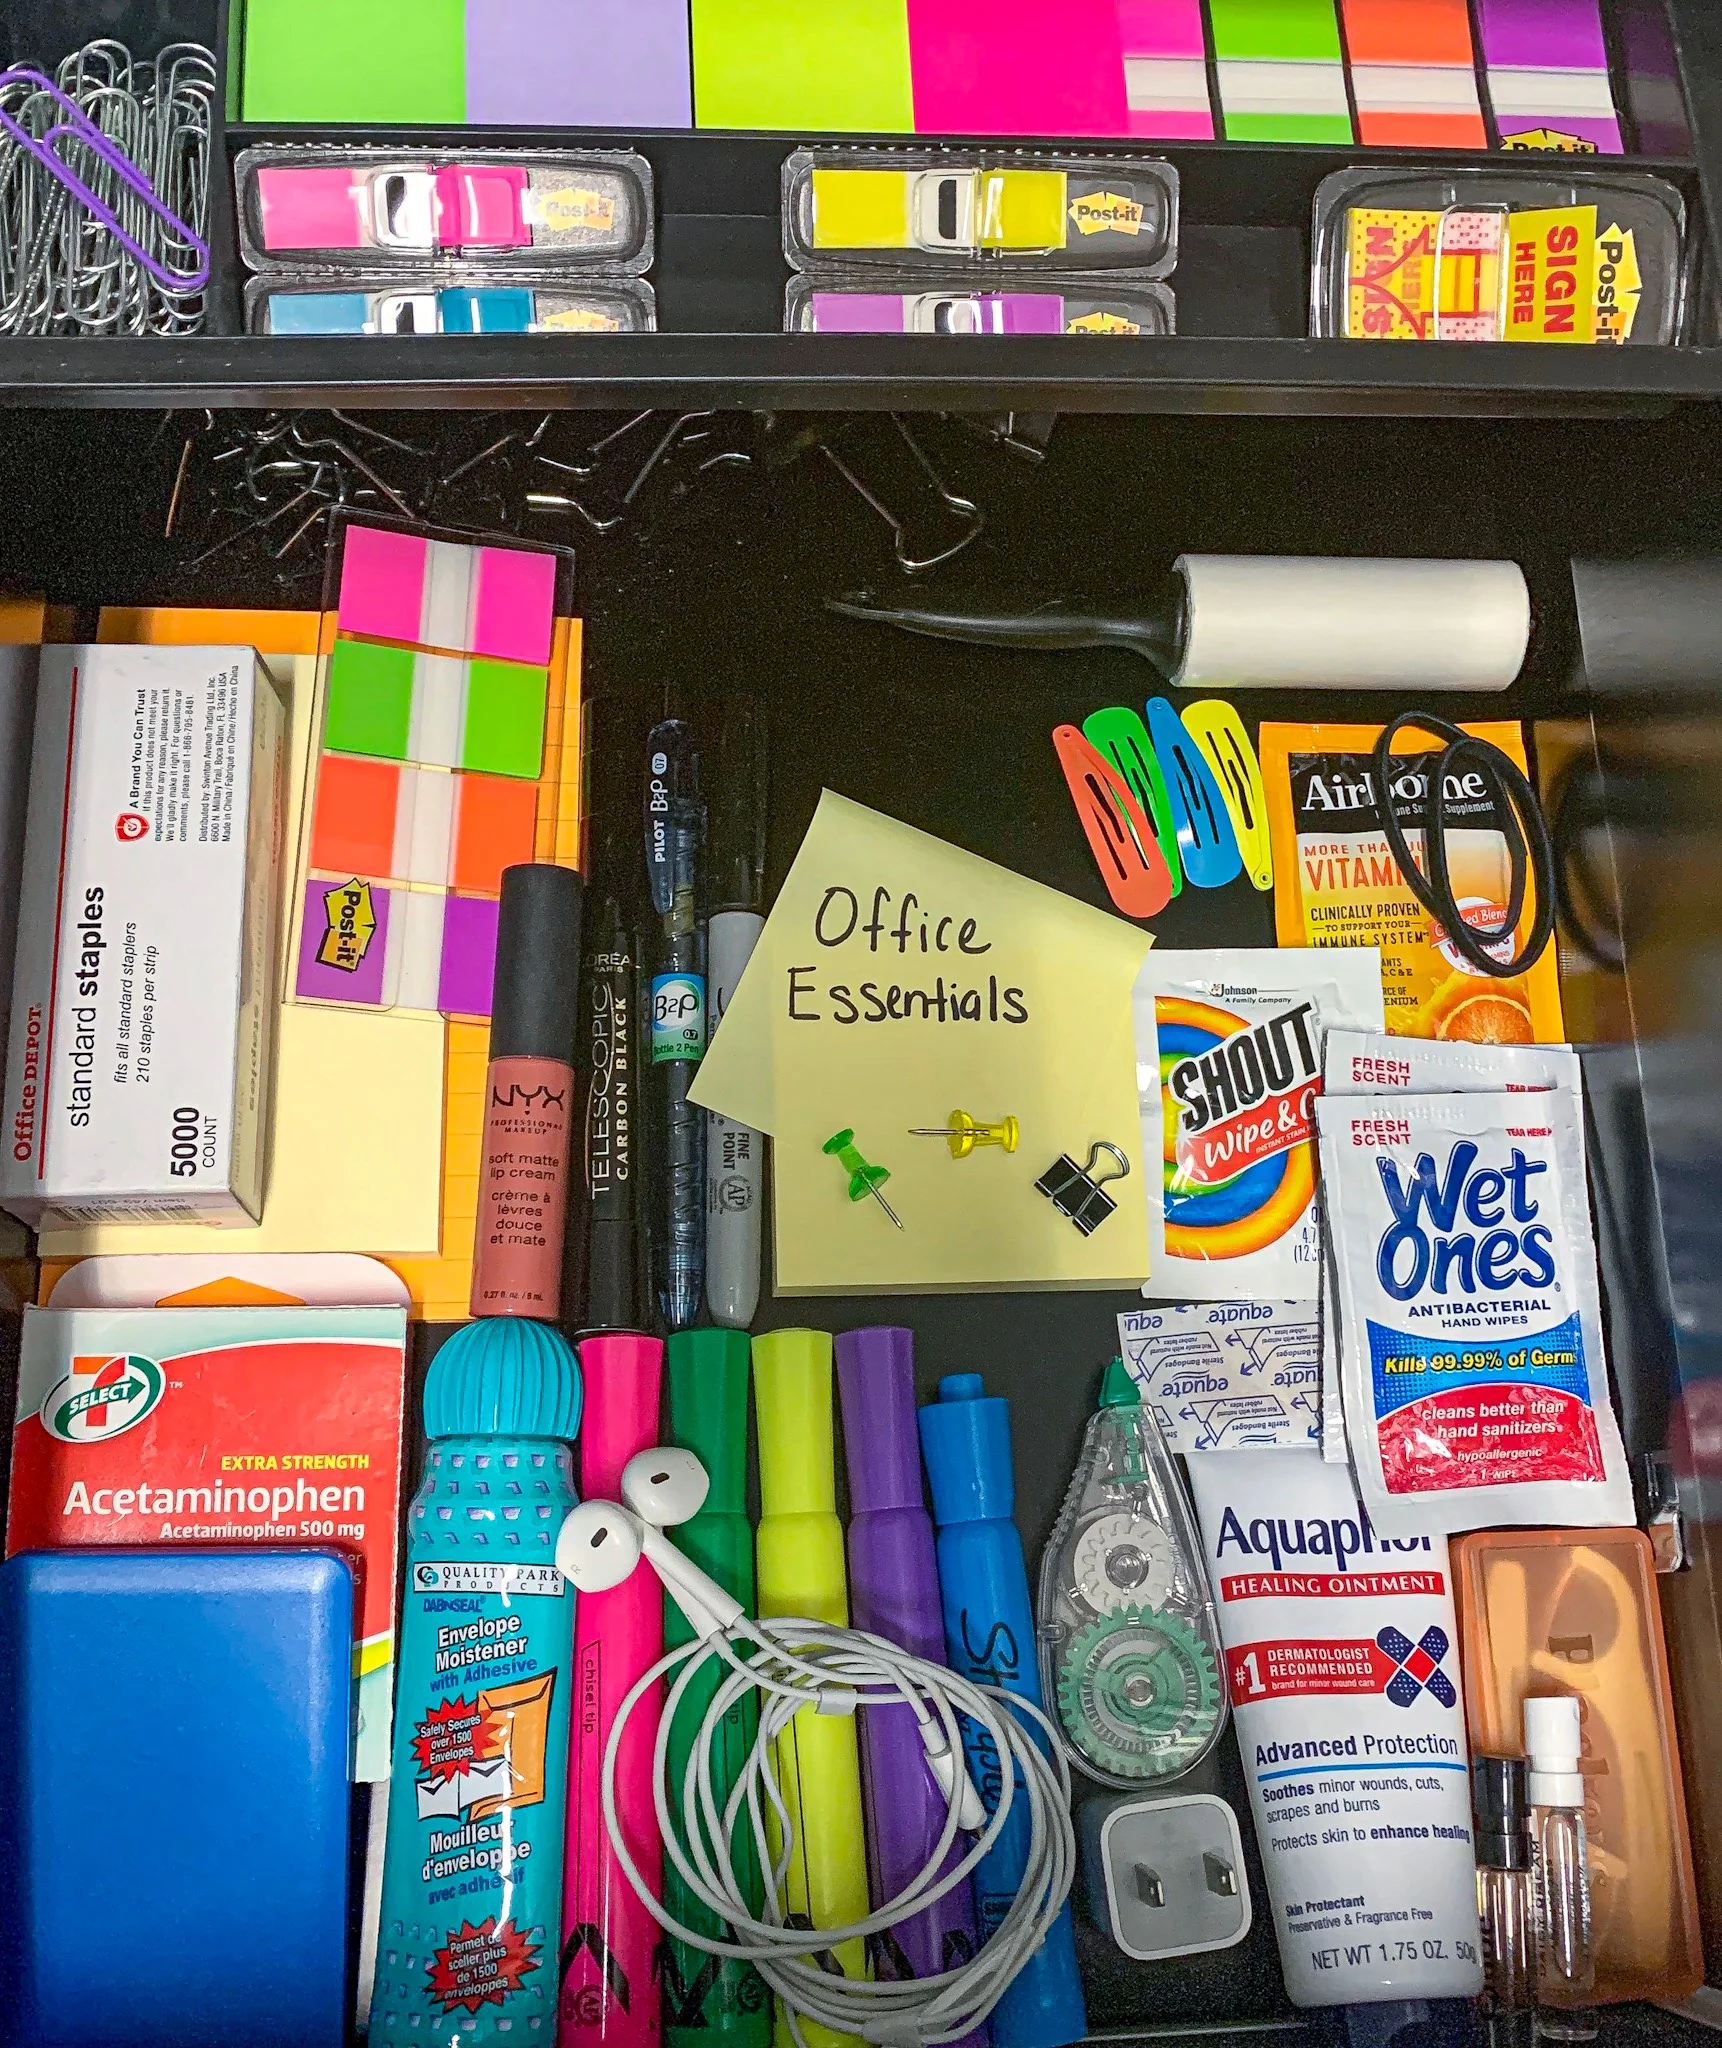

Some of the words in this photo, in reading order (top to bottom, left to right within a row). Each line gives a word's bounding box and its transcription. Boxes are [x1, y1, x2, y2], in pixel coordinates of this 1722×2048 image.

[1077, 205, 1138, 221] Post-it
[1514, 242, 1536, 324] HERE
[1544, 226, 1578, 334] SIGN
[135, 689, 145, 715] Trust
[134, 719, 143, 739] Can
[132, 743, 142, 762] You
[130, 766, 141, 797] Brand
[1445, 800, 1495, 816] Supplement
[654, 820, 665, 862] PILOT
[1304, 844, 1350, 857] MORE
[1357, 842, 1389, 854] THA
[815, 886, 992, 954] Office
[1311, 904, 1373, 921] CLINICALLY
[1377, 903, 1421, 918] PROVEN
[336, 890, 361, 962] Post-it
[1325, 924, 1338, 932] TO
[1341, 921, 1382, 932] SUPPORT
[1384, 919, 1411, 929] YOUR
[74, 887, 104, 999] staples
[124, 921, 136, 975] staplers
[143, 945, 160, 975] strip
[146, 984, 157, 1001] per
[787, 966, 1028, 1023] Essentials
[120, 979, 133, 1039] standard
[655, 994, 698, 1021] B2P
[139, 1006, 156, 1054] staples
[615, 997, 627, 1071] BLACK
[24, 1007, 41, 1081] DEPOT
[117, 1041, 129, 1059] all
[684, 1043, 699, 1054] Pen
[67, 1008, 96, 1127] standard
[114, 1063, 128, 1084] fits
[136, 1057, 150, 1083] 210
[1172, 1003, 1317, 1133] SHOUT
[1352, 1056, 1410, 1074] FRESH
[1352, 1071, 1411, 1087] SCENT
[492, 1084, 564, 1111] NYX
[592, 983, 611, 1200] TELESCOPIC
[14, 1084, 36, 1161] Office
[504, 1127, 547, 1135] MAKEUP
[616, 1083, 629, 1180] CARBON
[1351, 1120, 1409, 1132] FRESH
[170, 1107, 199, 1177] 5000
[202, 1115, 218, 1168] COUNT
[723, 1132, 736, 1170] POINT
[738, 1132, 750, 1159] FINE
[1204, 1118, 1275, 1170] Wipe
[1255, 1135, 1285, 1154] INSTANT
[1352, 1134, 1411, 1146] SCENT
[489, 1152, 513, 1164] soft
[519, 1153, 560, 1167] matte
[490, 1166, 505, 1179] lip
[510, 1169, 556, 1181] cream
[491, 1190, 539, 1202] crème
[543, 1192, 551, 1203] à
[1376, 1140, 1547, 1233] Wet
[497, 1203, 543, 1216] lèvres
[495, 1218, 543, 1231] douce
[490, 1232, 505, 1245] et
[508, 1233, 547, 1247] mate
[1377, 1224, 1555, 1301] Ones
[1208, 1304, 1273, 1325] equate
[1408, 1299, 1551, 1317] ANTIBACTERIAL
[1441, 1318, 1481, 1328] HAND
[1485, 1315, 1528, 1326] WIPES
[1165, 1359, 1200, 1368] Bandages
[1200, 1357, 1225, 1365] Sterile
[1385, 1356, 1424, 1373] Kills
[1431, 1351, 1503, 1371] 99.99%
[1508, 1349, 1527, 1366] of
[1161, 1374, 1229, 1398] equate
[68, 1383, 133, 1415] SELECT
[1422, 1403, 1476, 1421] cleans
[1479, 1402, 1525, 1418] better
[1531, 1401, 1564, 1414] than
[1437, 1423, 1477, 1439] hand
[1482, 1422, 1556, 1437] sanitizers
[221, 1456, 277, 1471] EXTRA
[281, 1454, 369, 1470] STRENGTH
[1457, 1449, 1543, 1464] hypoallergenic
[63, 1478, 365, 1521] Acetaminophen
[160, 1522, 296, 1540] Acetaminophen
[299, 1521, 334, 1537] 500
[338, 1524, 365, 1540] mg
[517, 1569, 560, 1581] PARK
[1231, 1578, 1321, 1596] HEALING
[1328, 1575, 1436, 1594] OINTMENT
[438, 1615, 520, 1648] Envelope
[436, 1636, 528, 1673] Moistener
[1268, 1647, 1370, 1662] DERMATOLOGIST
[430, 1671, 459, 1692] with
[464, 1658, 537, 1685] Adhesive
[584, 1657, 596, 1705] chisel
[1235, 1651, 1267, 1694] #1
[1269, 1662, 1373, 1677] RECOMMENDED
[420, 1724, 446, 1740] Safely
[448, 1713, 481, 1731] Secures
[583, 1707, 595, 1734] tip
[431, 1736, 450, 1750] over
[451, 1730, 472, 1745] 1500
[1256, 1735, 1357, 1766] Advanced
[1363, 1734, 1458, 1755] Protection
[430, 1747, 474, 1764] Envelopes
[1263, 1782, 1314, 1803] Soothes
[1319, 1779, 1355, 1794] minor
[1360, 1776, 1413, 1791] wounds,
[1415, 1776, 1444, 1791] cuts,
[1267, 1803, 1310, 1823] scrapes
[1315, 1799, 1340, 1815] and
[1344, 1797, 1380, 1812] burns
[1272, 1832, 1317, 1852] Protects
[1322, 1828, 1350, 1844] skin
[1353, 1828, 1366, 1841] to
[1370, 1825, 1429, 1840] enhance
[1432, 1824, 1470, 1843] healing
[429, 1887, 456, 1905] avec
[1286, 1904, 1303, 1917] Skin
[1306, 1895, 1365, 1914] Protectant
[1288, 1916, 1341, 1933] Preservative
[1344, 1914, 1353, 1925] &
[1355, 1909, 1409, 1926] Fragrance
[1411, 1908, 1433, 1920] Free
[450, 1935, 485, 1954] Permet
[1312, 1948, 1340, 1970] NET
[1345, 1945, 1371, 1965] WT
[1380, 1942, 1418, 1962] 1.75
[1423, 1941, 1448, 1959] OZ.
[1456, 1942, 1477, 1963] 50g
[449, 1953, 481, 1970] sceller
[483, 1947, 507, 1963] plus
[473, 1963, 498, 1980] 1500
[444, 1978, 508, 1999] enveloppes
